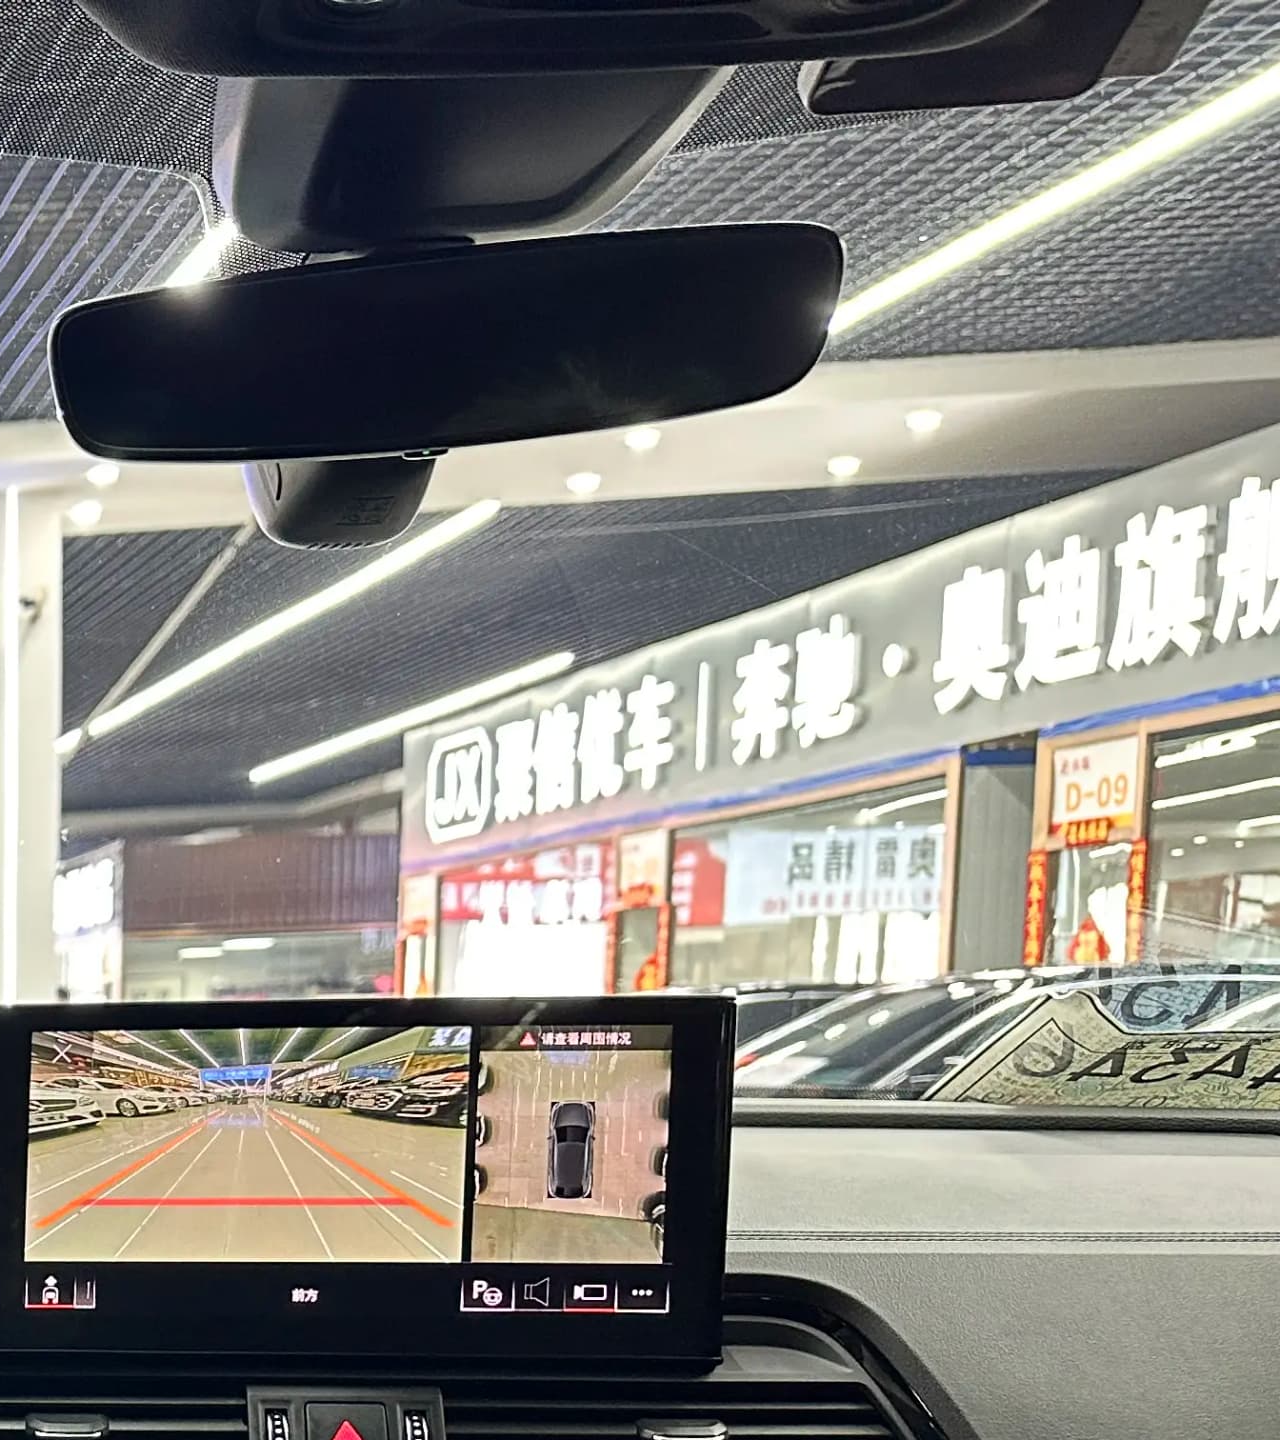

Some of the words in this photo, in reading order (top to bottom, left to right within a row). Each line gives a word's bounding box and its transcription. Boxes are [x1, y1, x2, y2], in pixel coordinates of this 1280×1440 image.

[1065, 773, 1130, 813] D-09
[541, 1031, 633, 1046] 请查看周围情况
[291, 1288, 318, 1303] 前方
